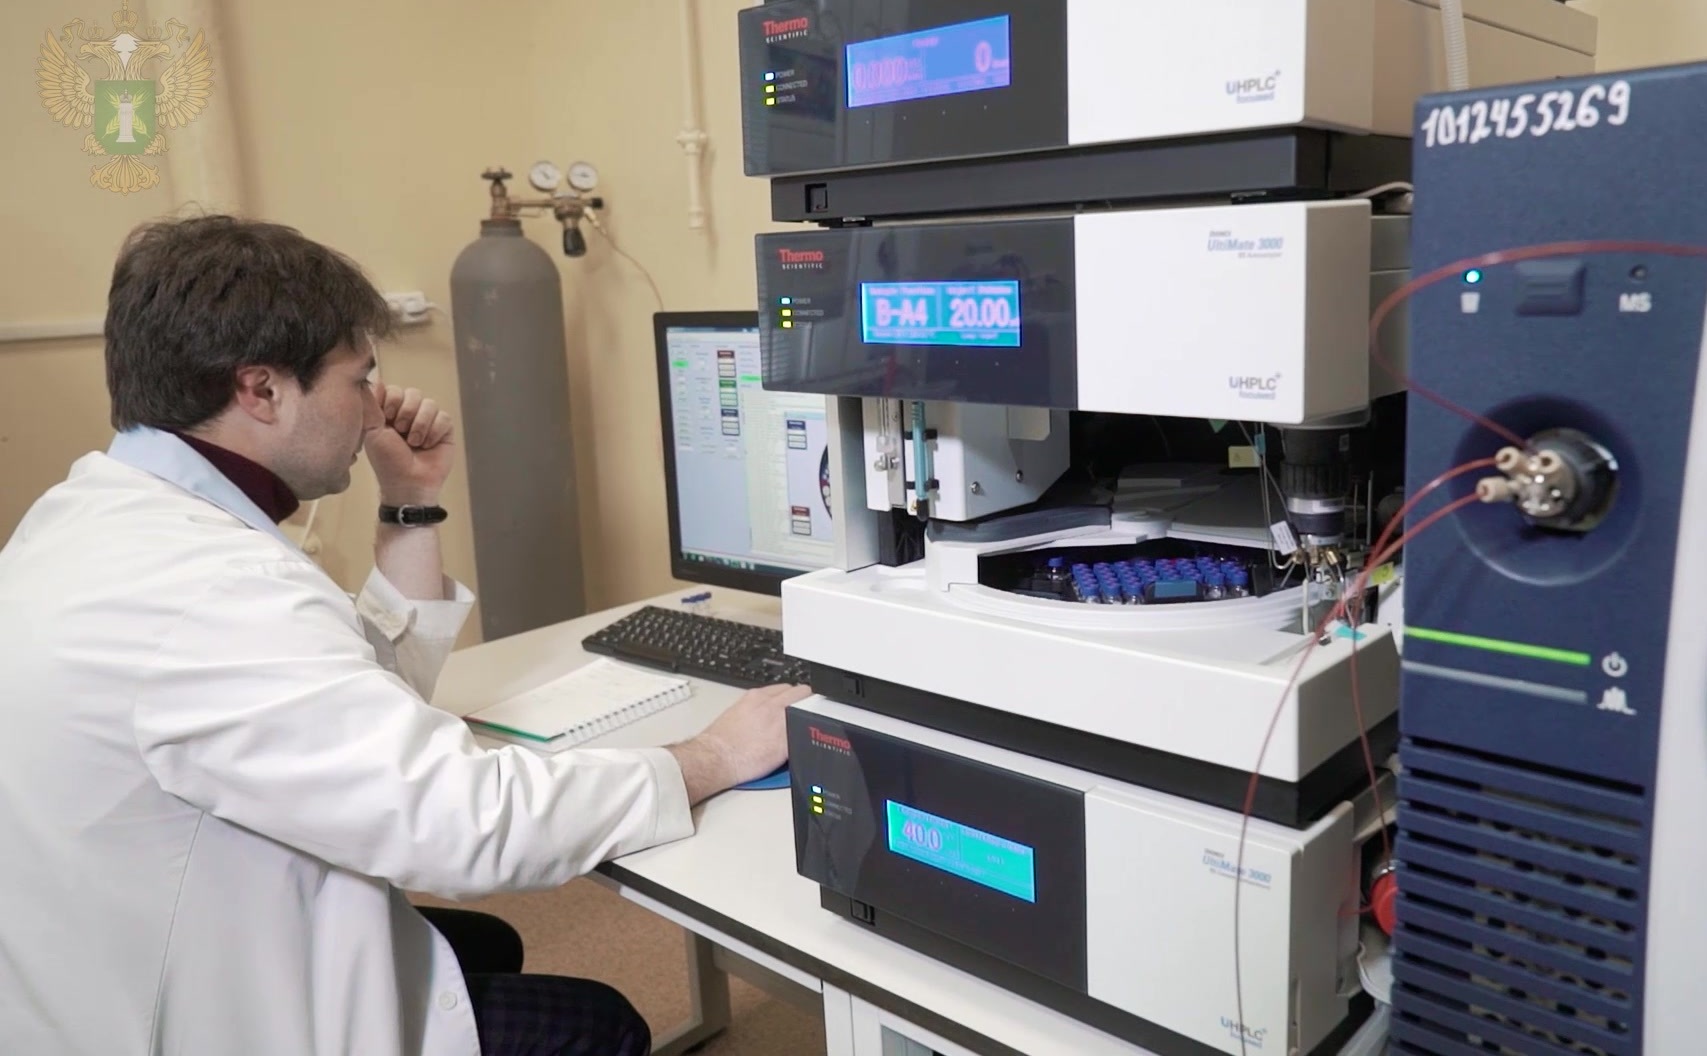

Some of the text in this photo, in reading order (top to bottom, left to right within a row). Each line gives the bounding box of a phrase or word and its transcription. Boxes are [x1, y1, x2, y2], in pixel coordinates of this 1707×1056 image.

[763, 17, 808, 36] Thermo
[766, 29, 808, 44] SCIENTIFIC
[1421, 80, 1631, 148] 1012455269
[1207, 236, 1284, 252] UltiMate 3000
[780, 249, 824, 262] Thermo
[782, 262, 823, 270] SCIENTIFIC
[1619, 292, 1652, 312] MS
[949, 297, 1010, 328] 20.00
[808, 726, 851, 750] Thermo
[904, 820, 942, 851] 40.0
